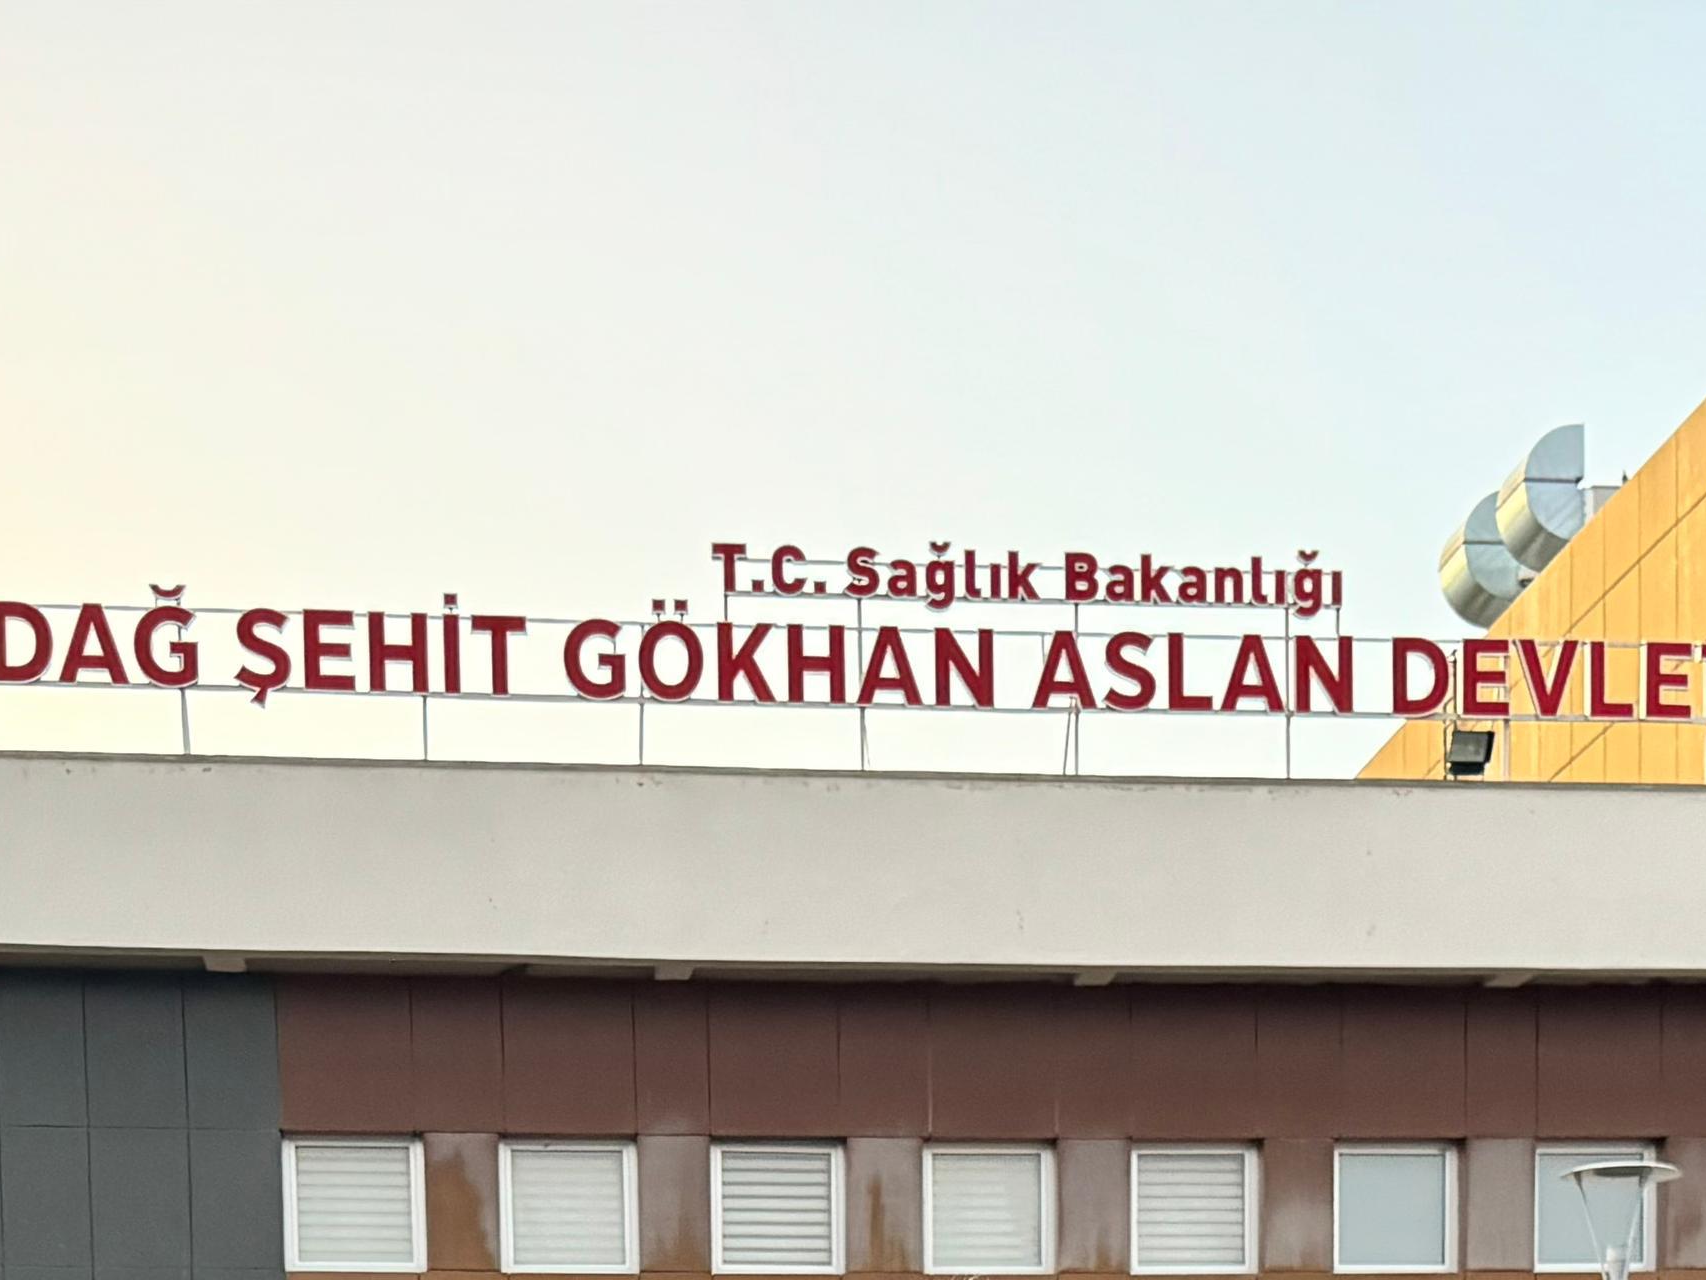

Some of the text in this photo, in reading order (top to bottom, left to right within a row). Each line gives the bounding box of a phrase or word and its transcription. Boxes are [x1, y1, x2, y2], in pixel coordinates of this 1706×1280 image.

[712, 541, 1344, 617] T.C. Sağlık Bakanlığı
[235, 592, 526, 705] ŞEHİT
[563, 599, 995, 708] GÖKHAN
[1032, 630, 1354, 714] ASLAN
